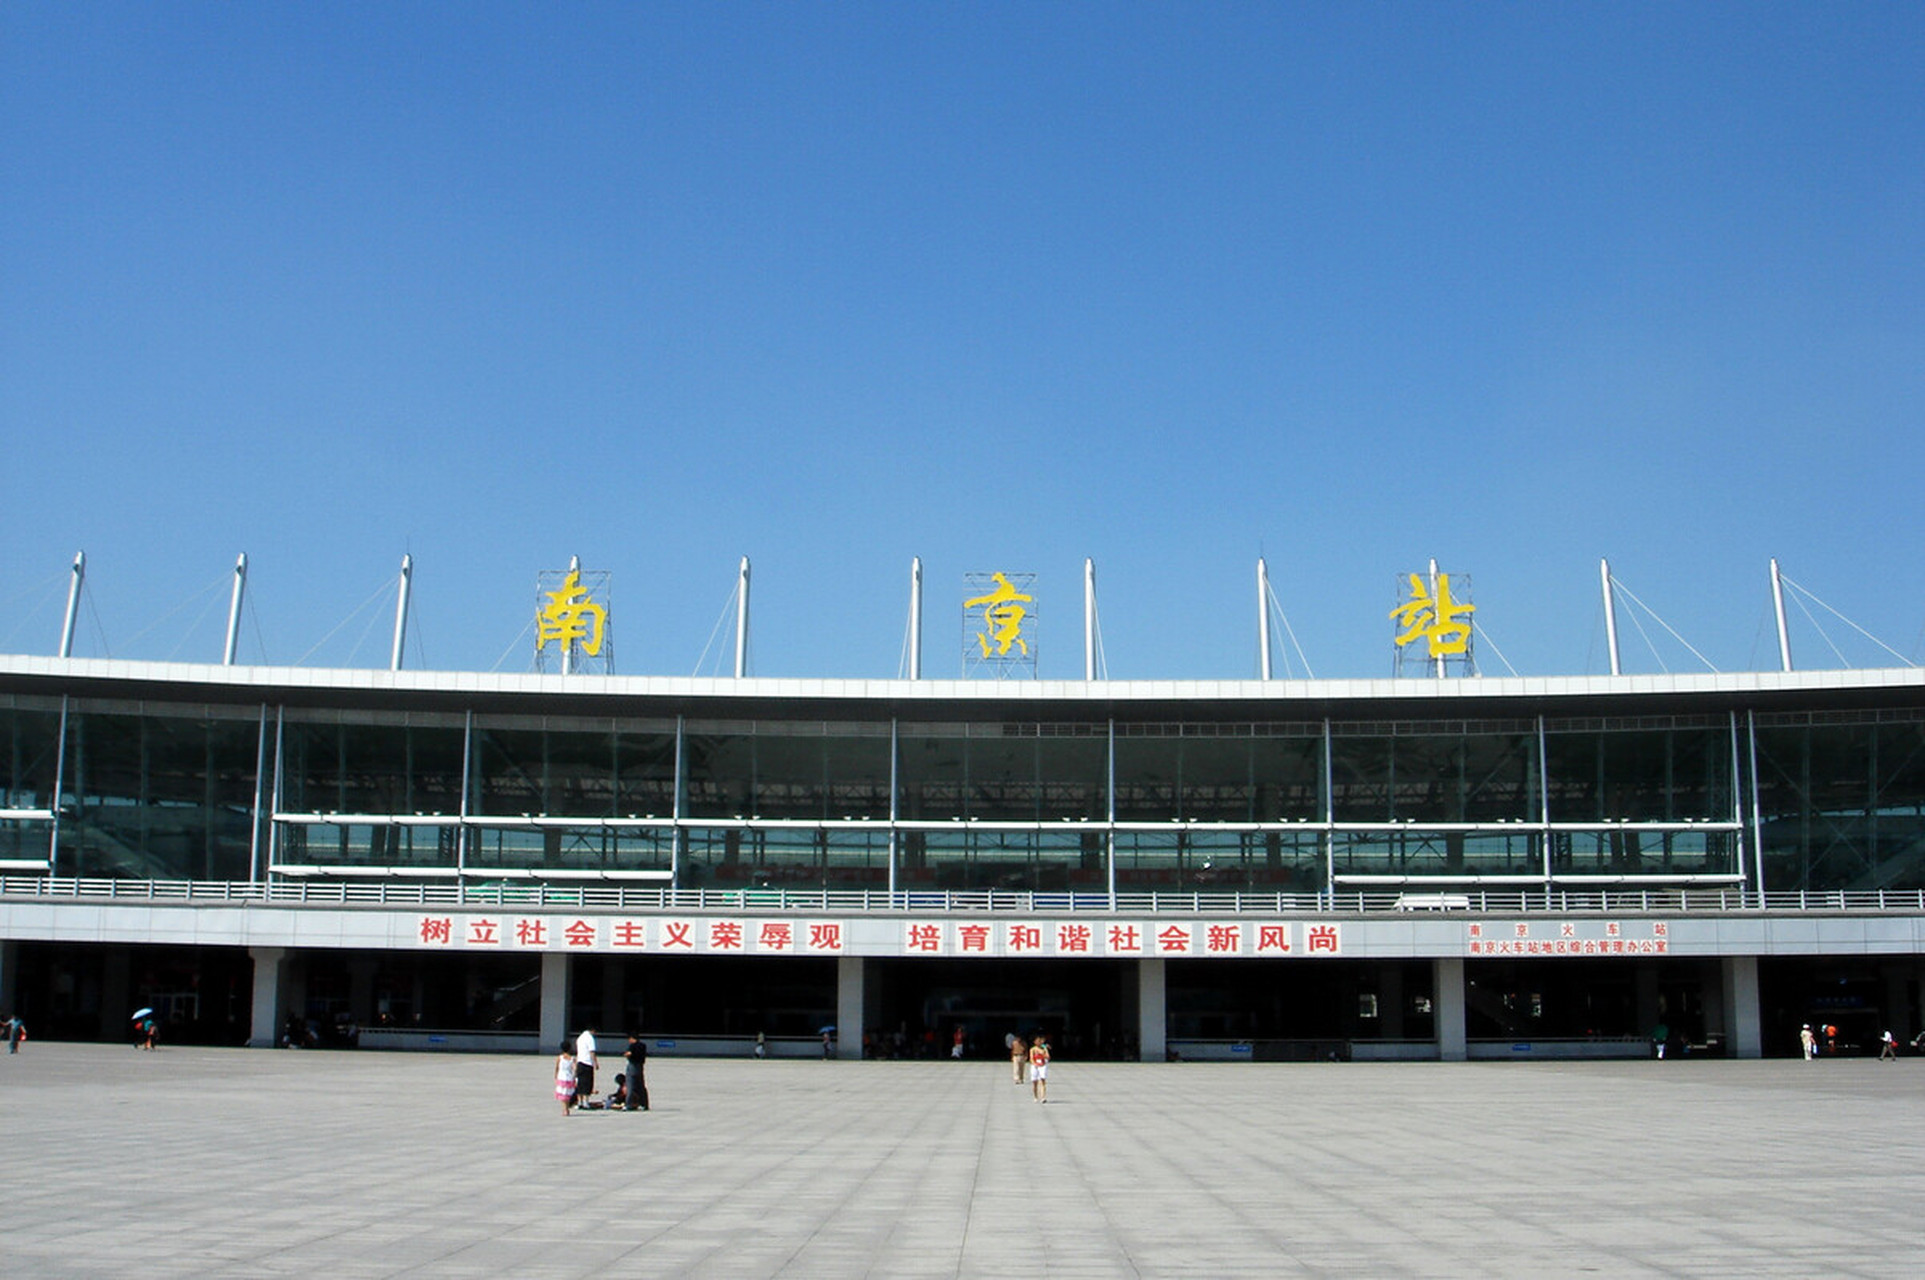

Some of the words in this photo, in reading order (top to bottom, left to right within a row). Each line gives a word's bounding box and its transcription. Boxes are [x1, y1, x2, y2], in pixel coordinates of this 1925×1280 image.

[420, 917, 842, 950] 树立社会主义荣辱观
[908, 924, 1338, 953] 培育和谐社会新风尚
[1469, 923, 1666, 936] 南京火车站
[1469, 940, 1666, 954] 南京火车站地区综合管理办公室
